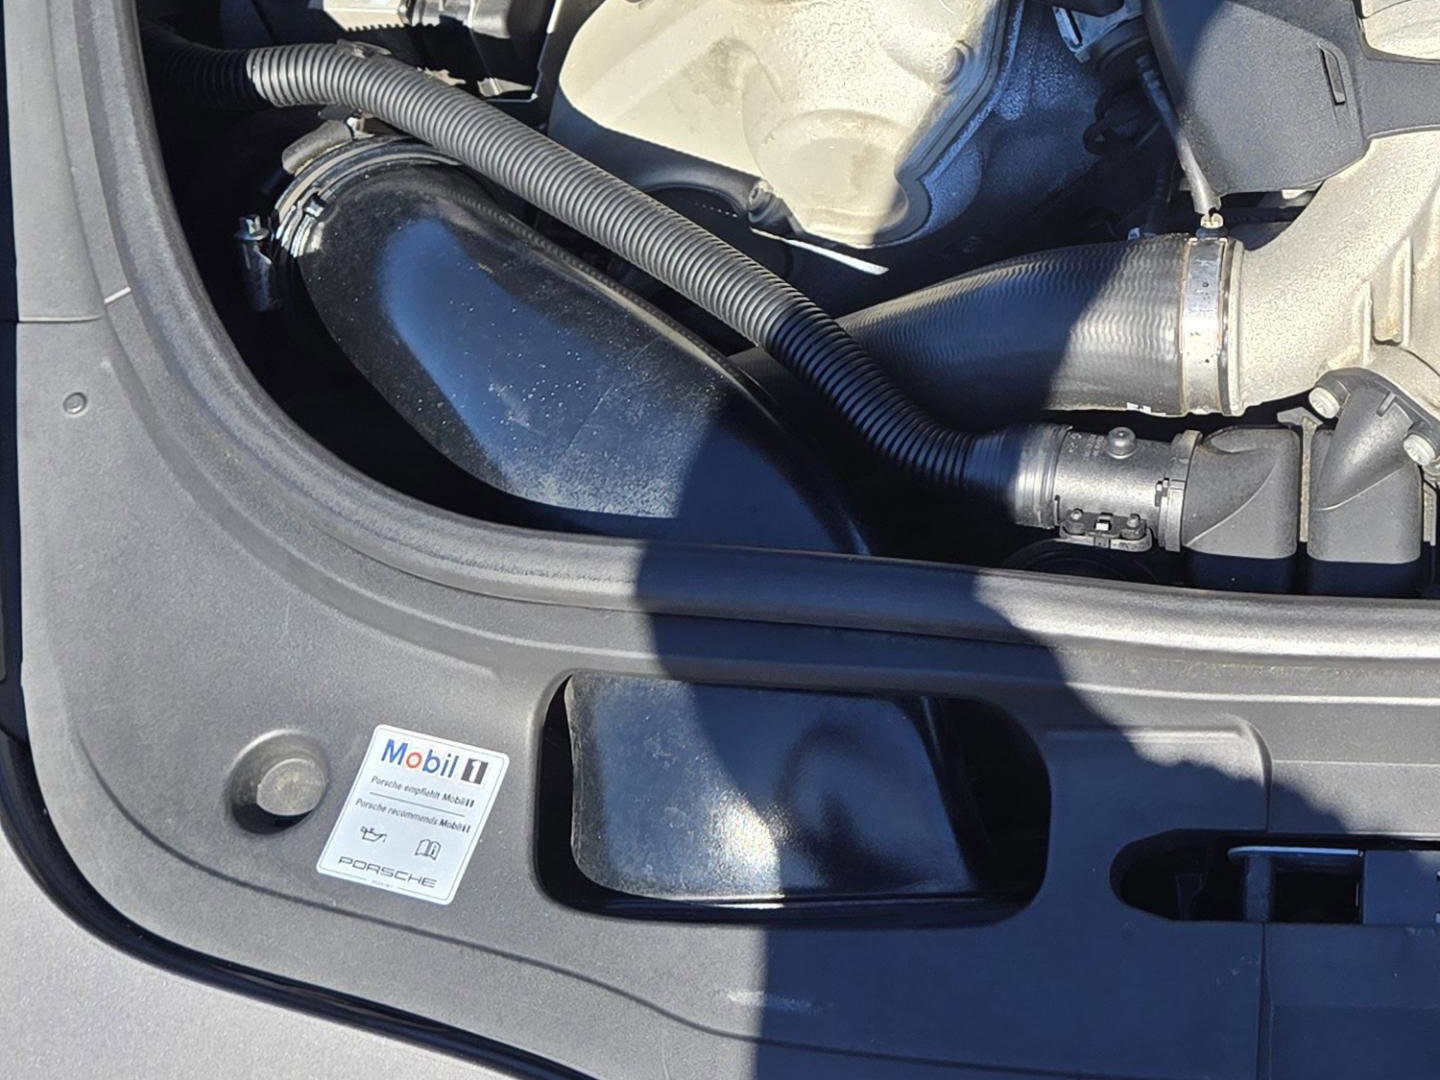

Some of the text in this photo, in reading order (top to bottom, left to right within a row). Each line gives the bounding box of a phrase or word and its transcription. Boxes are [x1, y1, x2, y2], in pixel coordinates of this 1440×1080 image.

[380, 739, 489, 785] Mobil 1
[371, 775, 402, 790] Porsche
[355, 798, 387, 815] Porsche
[388, 807, 437, 825] recommends
[337, 856, 437, 888] PORSCHE
